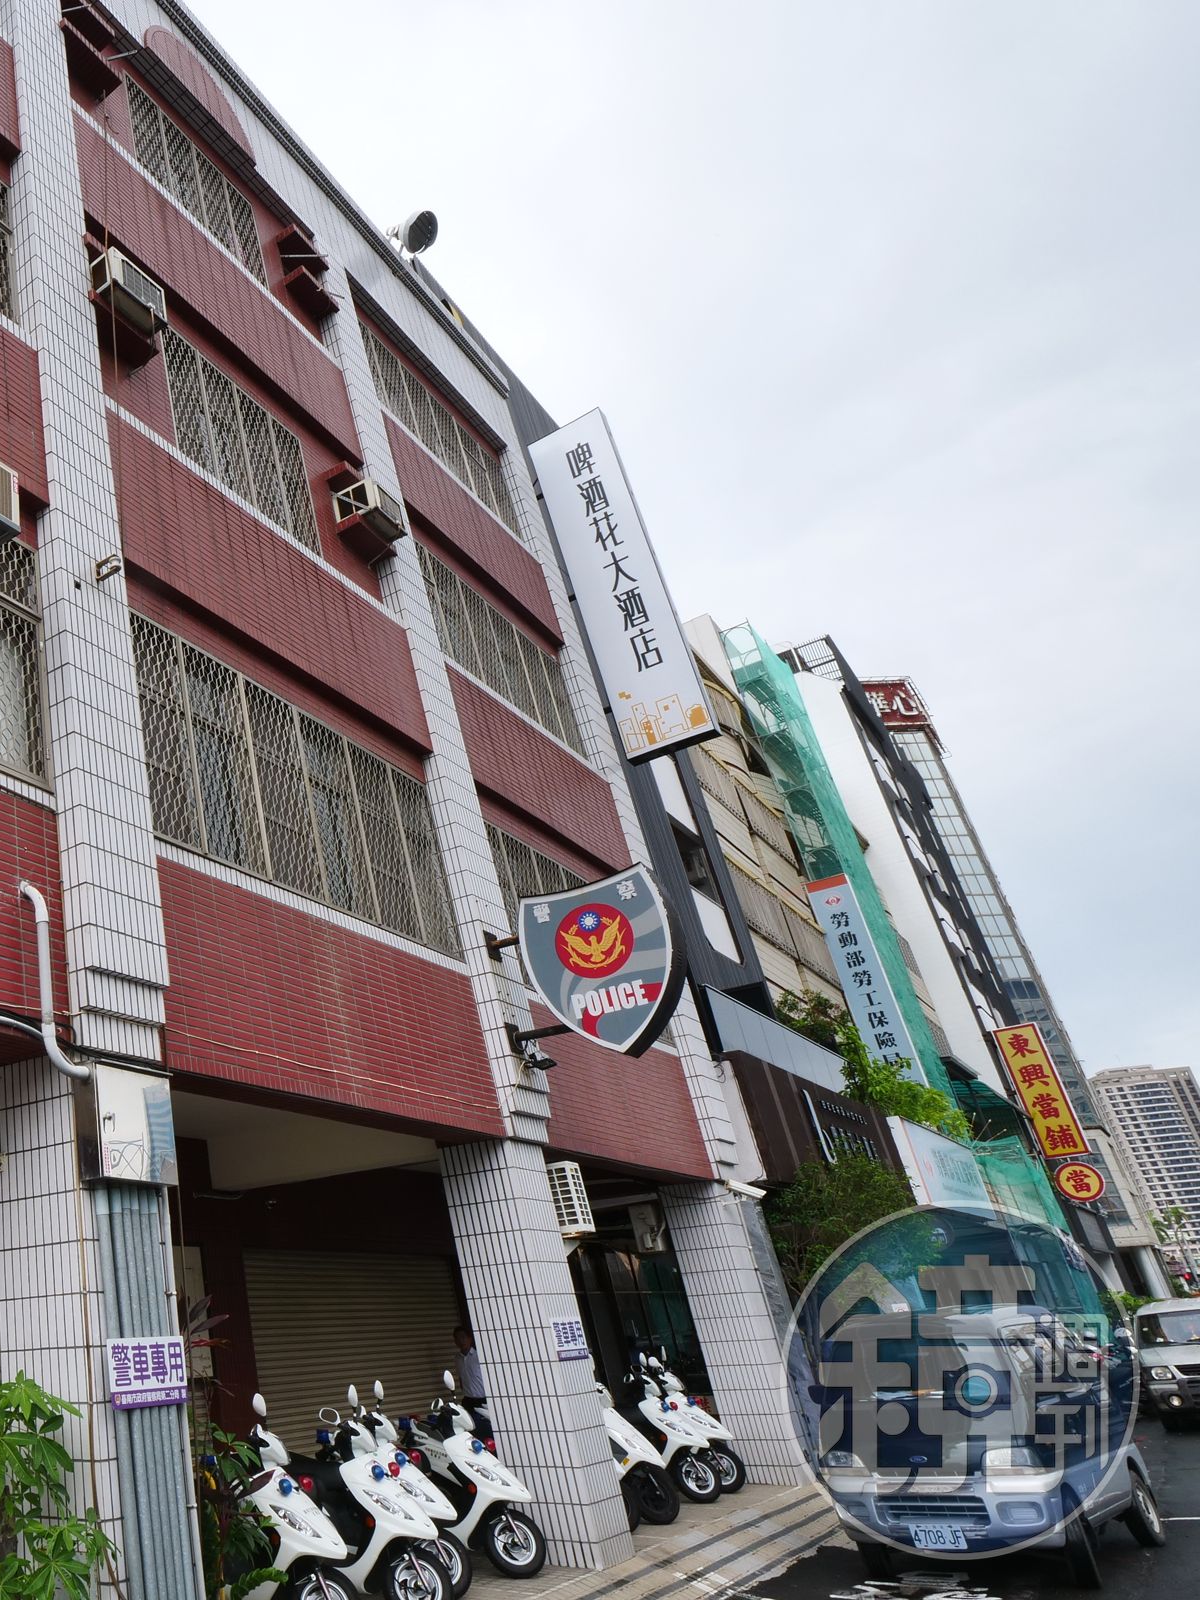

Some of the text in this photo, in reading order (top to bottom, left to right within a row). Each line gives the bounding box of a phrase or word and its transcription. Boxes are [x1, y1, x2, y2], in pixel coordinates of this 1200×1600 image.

[565, 442, 664, 673] 啤酒花大酒店
[570, 979, 649, 1020] POLICE
[1066, 1169, 1092, 1194] 當
[111, 1342, 185, 1387] 警車專用
